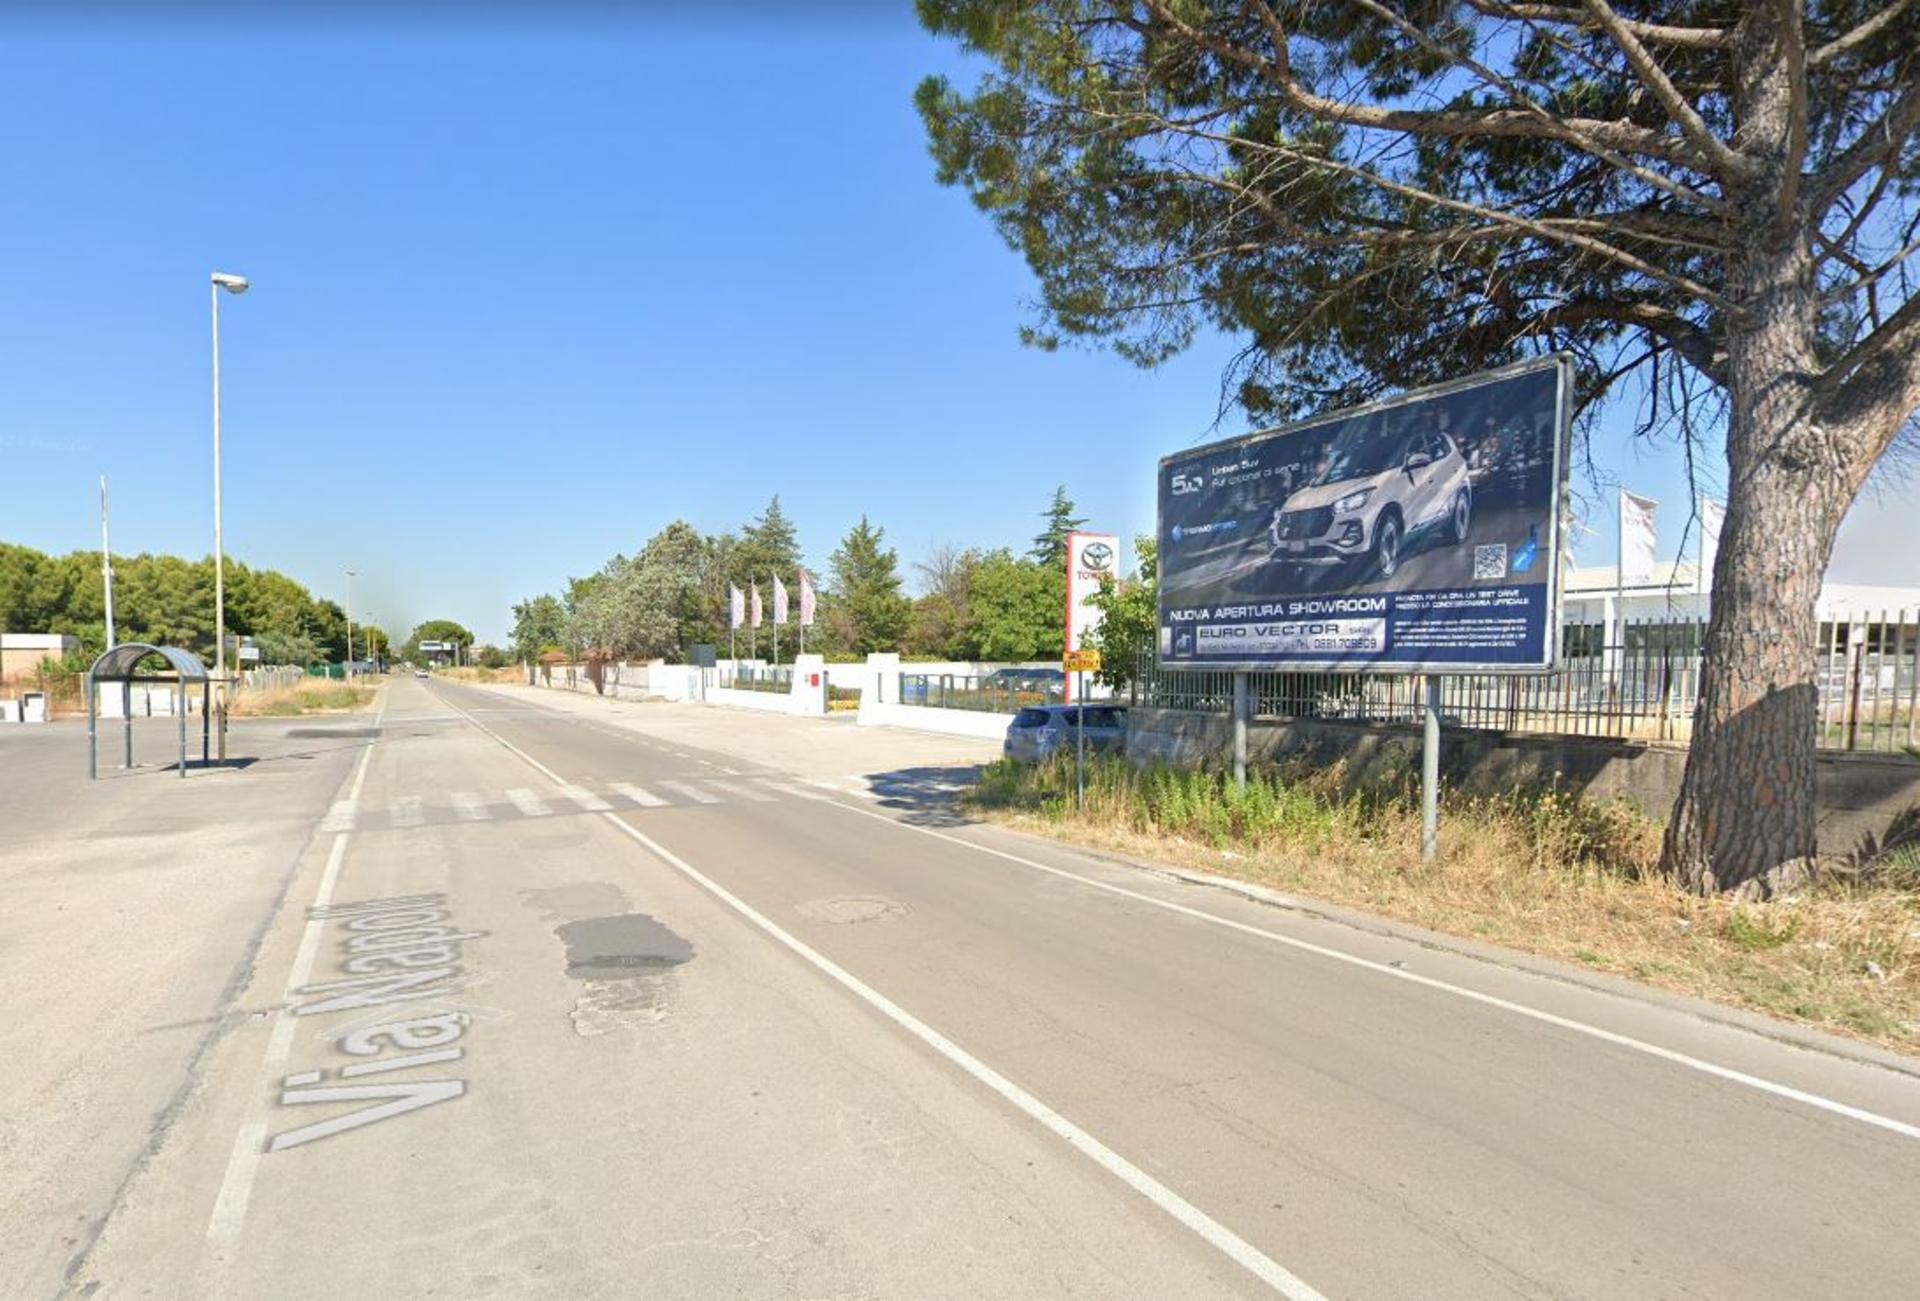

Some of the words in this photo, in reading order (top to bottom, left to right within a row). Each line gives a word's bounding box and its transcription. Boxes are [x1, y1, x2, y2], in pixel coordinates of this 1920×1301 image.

[1170, 608, 1210, 621] NUOVA
[1214, 604, 1284, 620] APERTURA
[1289, 598, 1386, 616] SHOWROOM
[1200, 627, 1247, 638] EURO
[1254, 624, 1339, 636] VECTOR
